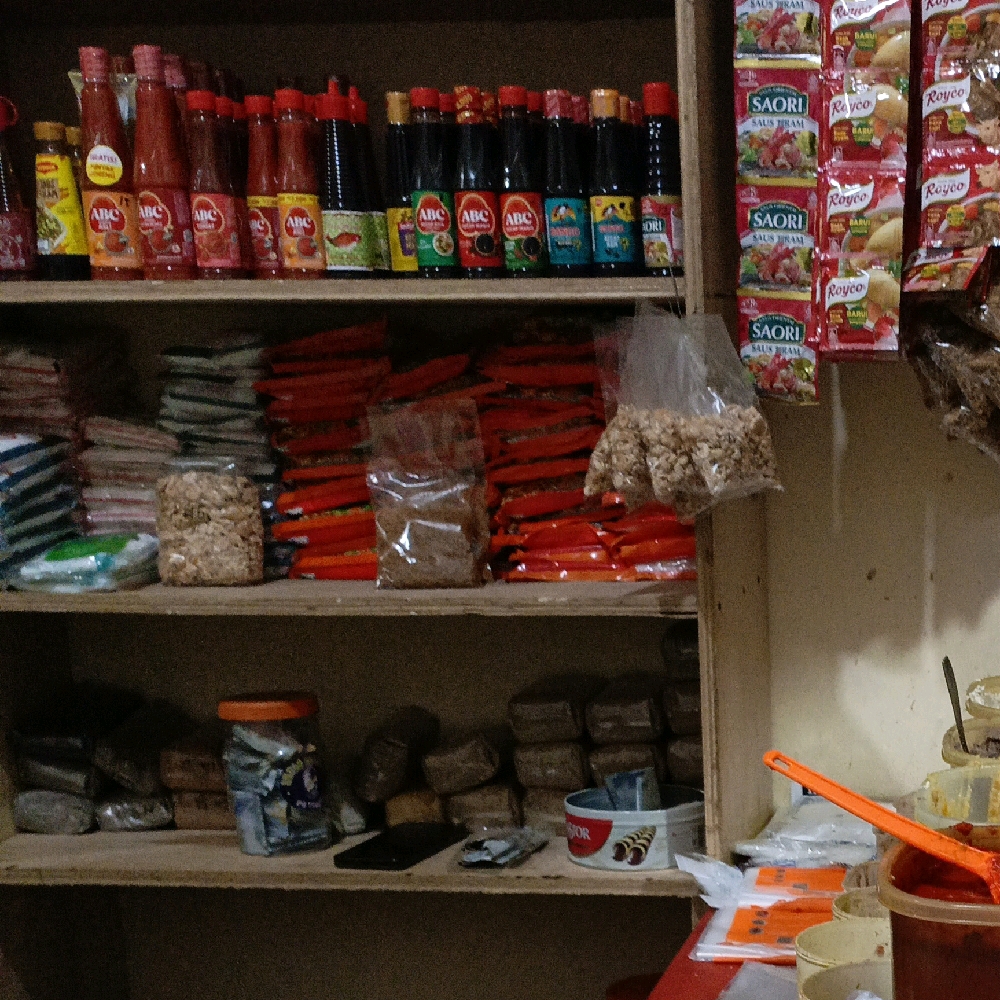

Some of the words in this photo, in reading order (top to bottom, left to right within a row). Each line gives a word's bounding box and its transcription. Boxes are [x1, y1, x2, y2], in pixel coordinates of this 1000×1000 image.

[752, 96, 803, 113] SAORI
[927, 87, 965, 107] Royco
[926, 181, 965, 199] Royco
[829, 192, 867, 208] Royco
[90, 208, 120, 222] ABC
[138, 205, 164, 219] ABC
[194, 210, 218, 223] ABC
[419, 208, 446, 221] ABC
[461, 210, 489, 223] ABC
[506, 211, 533, 226] ABC
[287, 216, 312, 229] ABC
[753, 212, 803, 230] SAORI
[828, 284, 864, 300] Royco
[752, 322, 801, 341] SAORI
